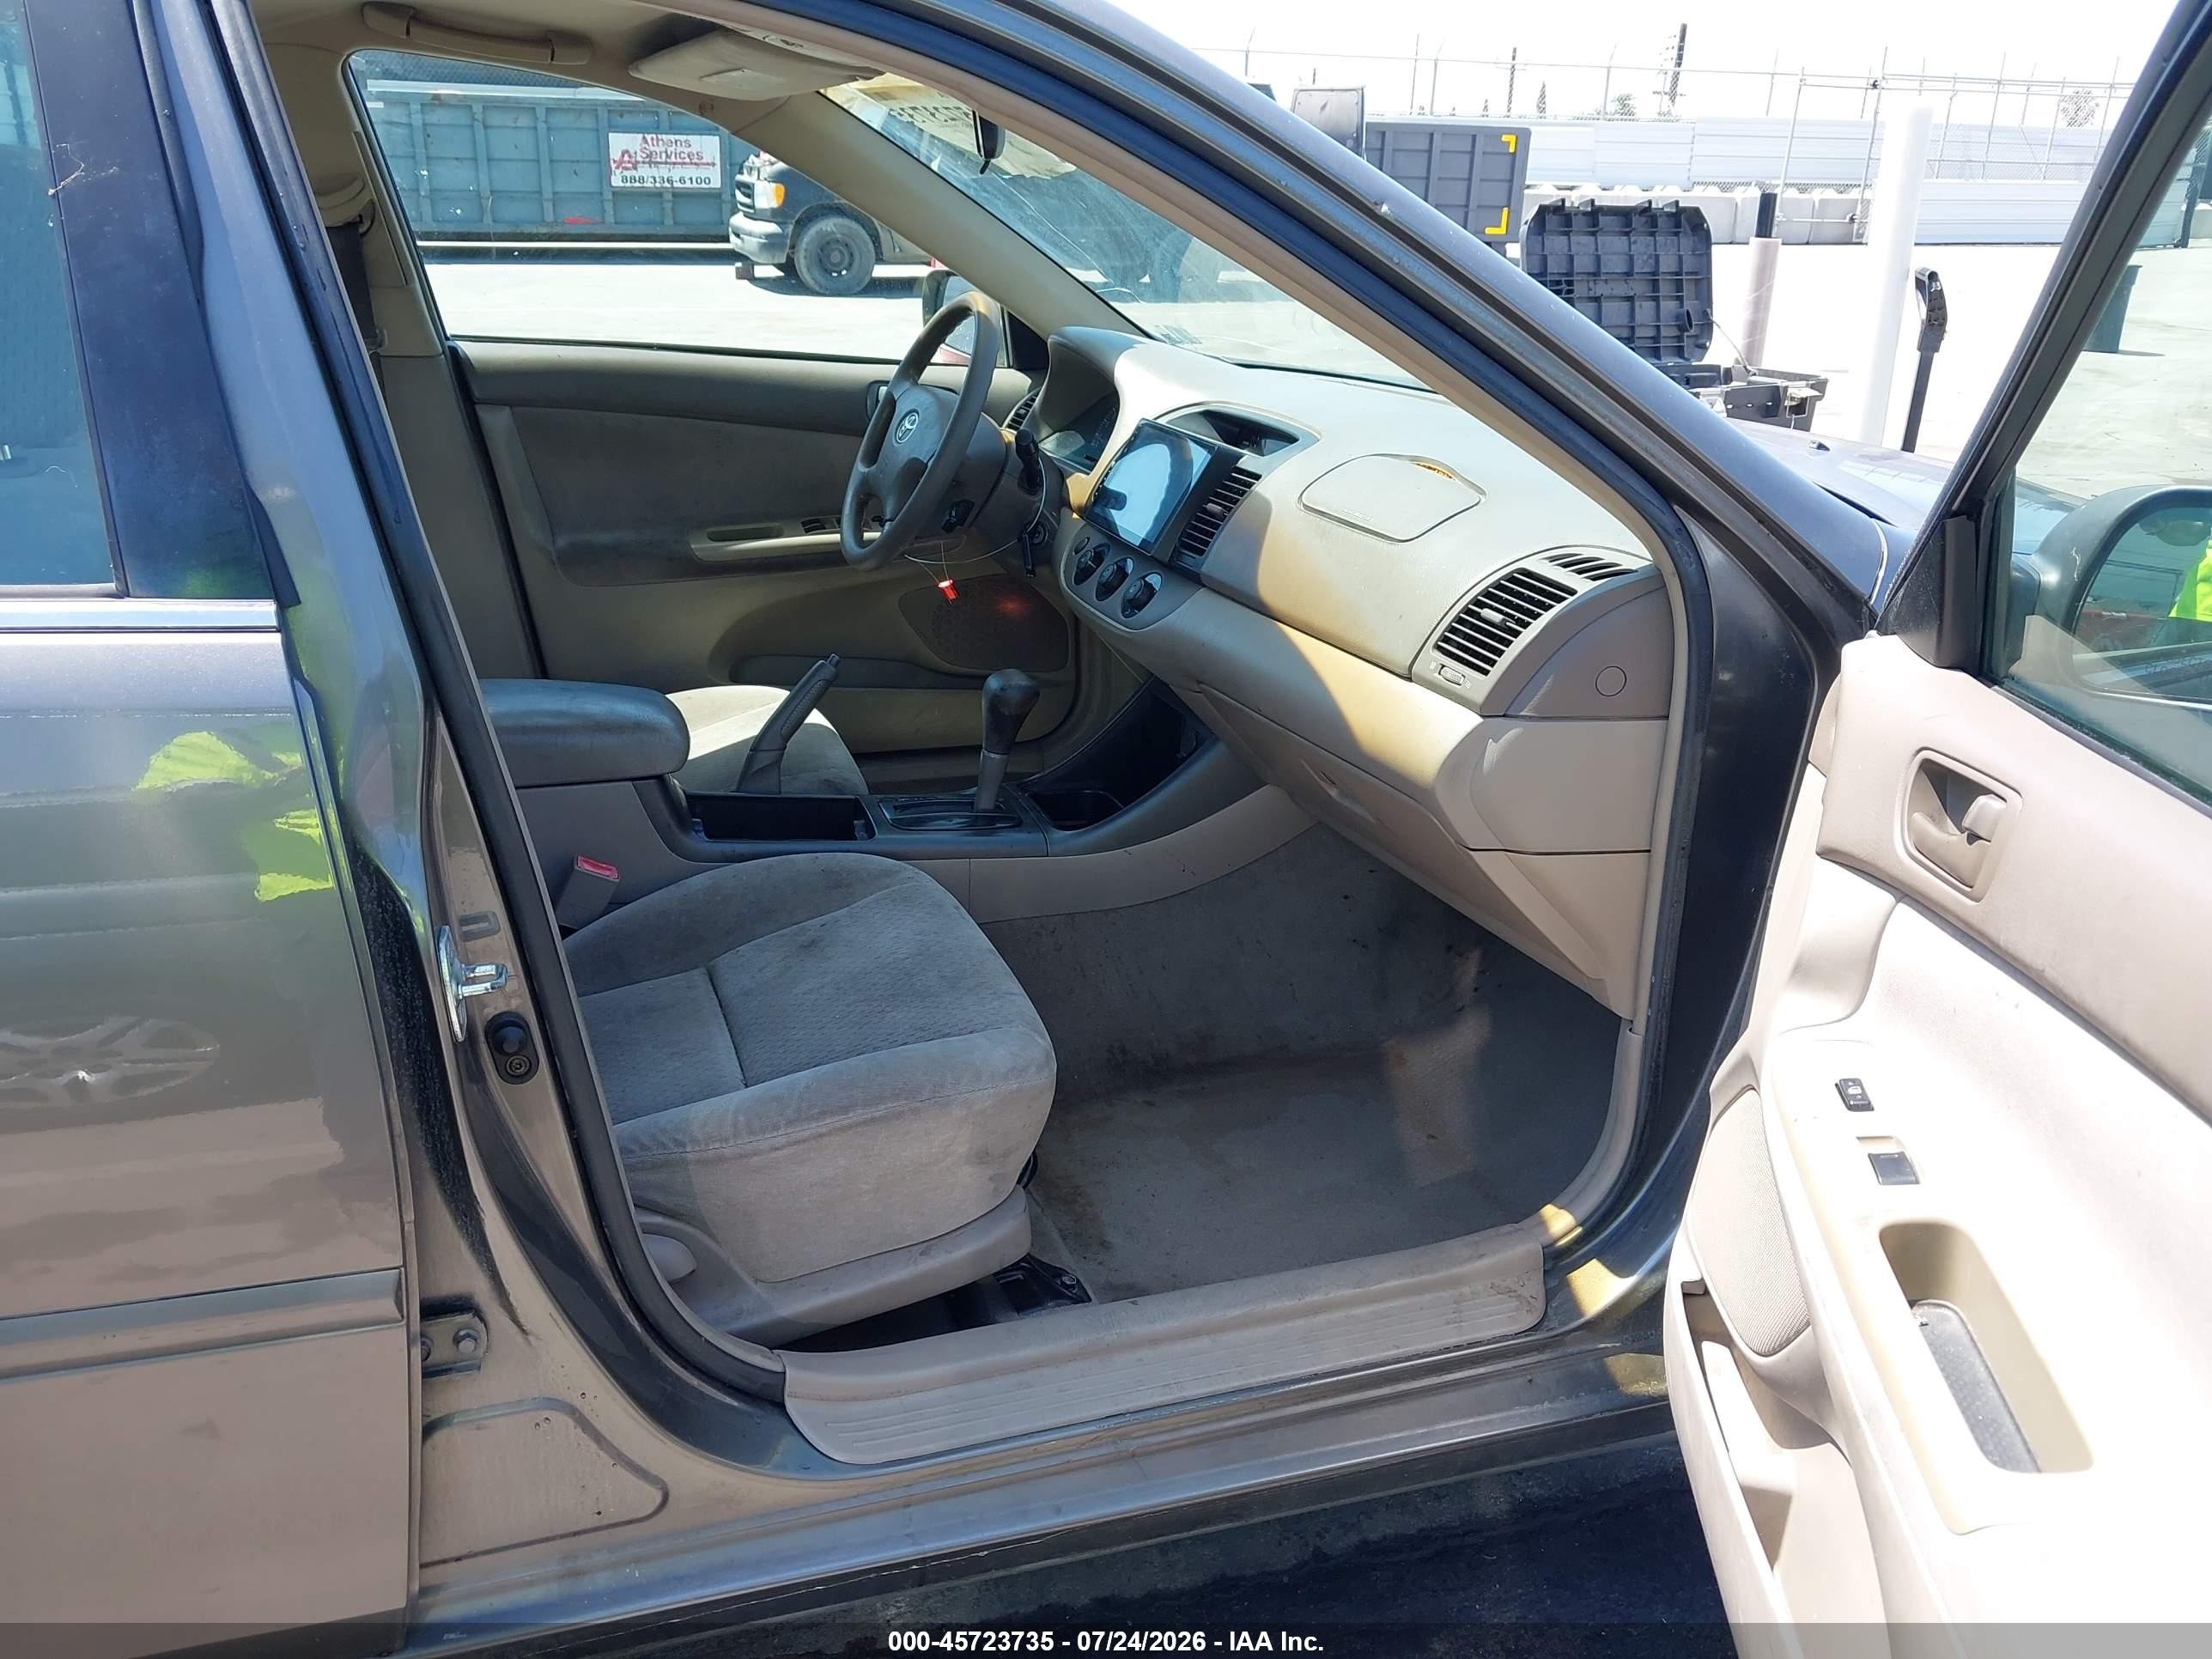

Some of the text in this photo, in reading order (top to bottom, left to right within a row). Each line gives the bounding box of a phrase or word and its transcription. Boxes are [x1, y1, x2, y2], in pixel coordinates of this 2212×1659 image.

[640, 135, 691, 148] Athens
[640, 148, 704, 161] Services
[621, 175, 711, 185] 888/336-6100
